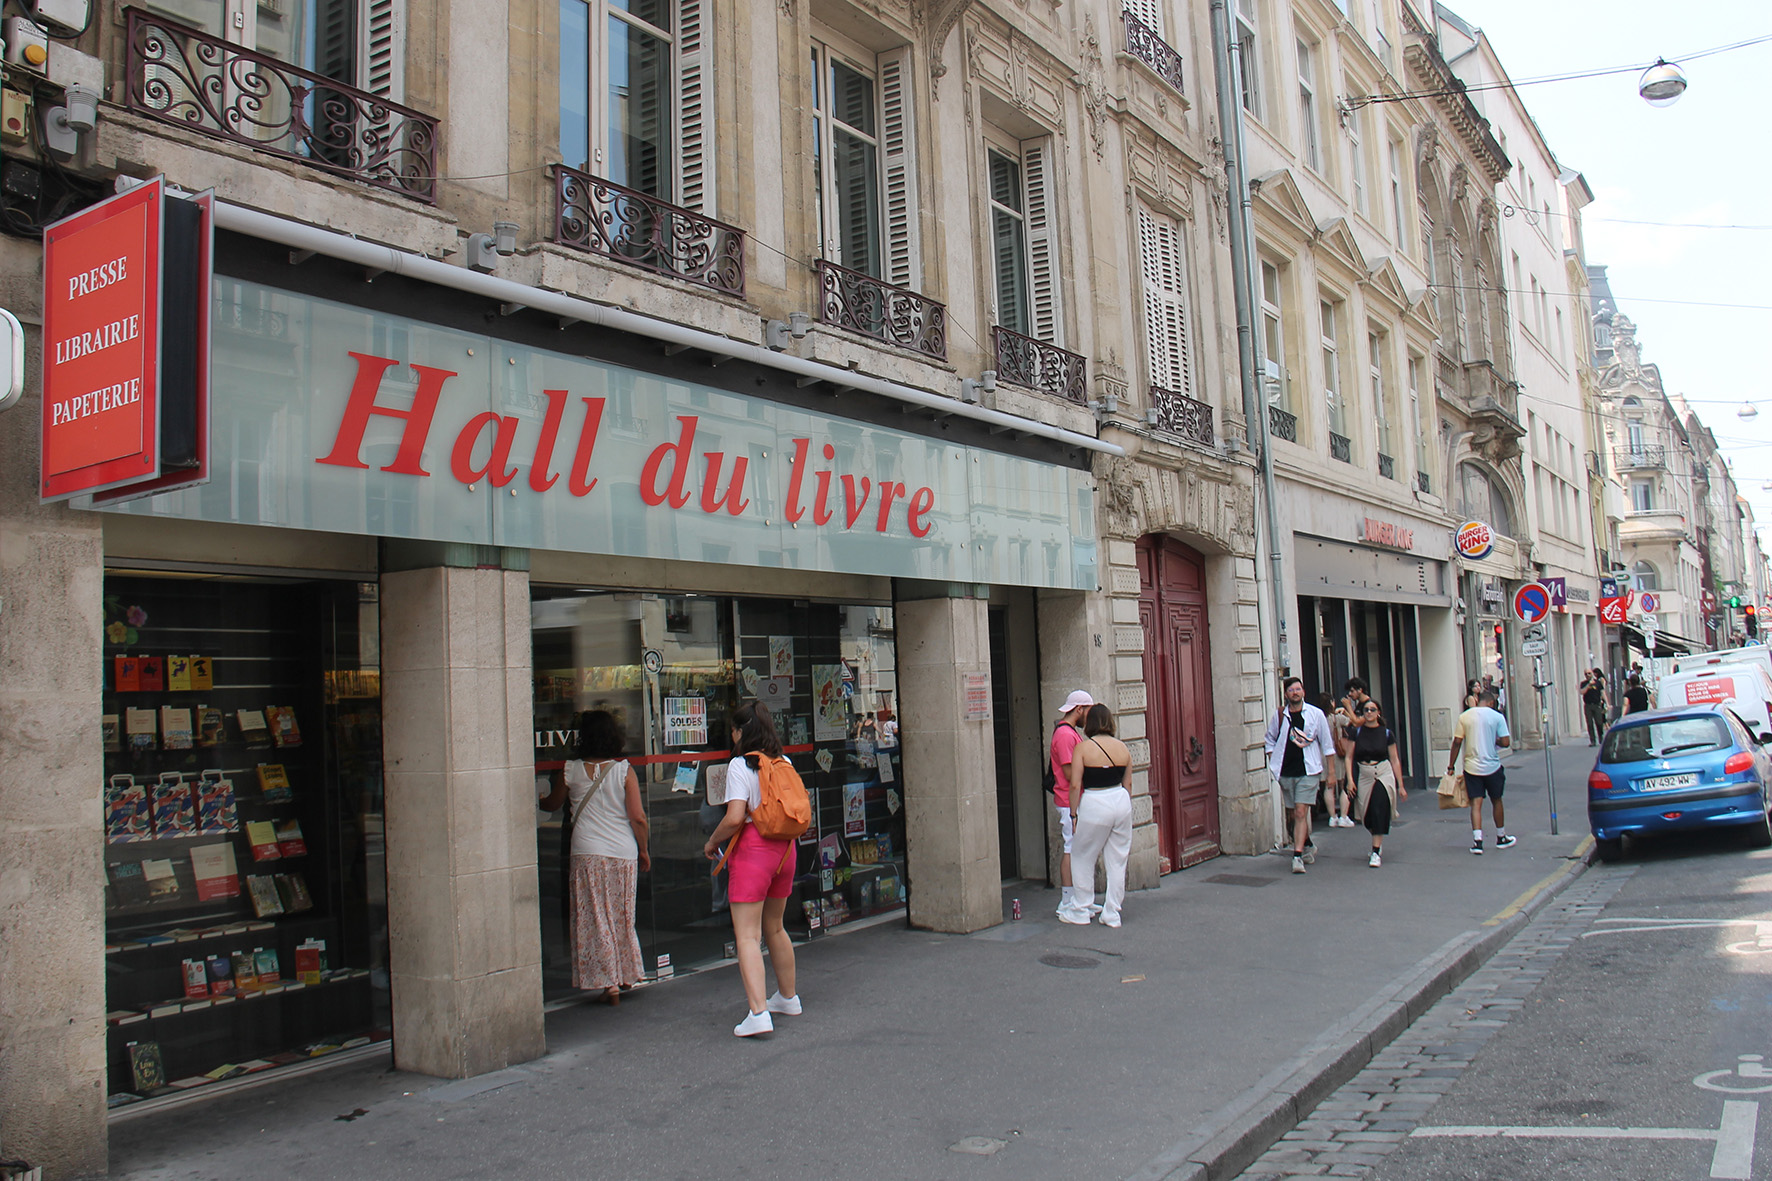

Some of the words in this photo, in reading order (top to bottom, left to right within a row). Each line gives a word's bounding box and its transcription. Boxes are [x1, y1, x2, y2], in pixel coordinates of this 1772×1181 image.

[68, 256, 127, 300] PRESSE
[55, 314, 139, 365] LIBRAIRIE
[52, 377, 140, 427] PAPETERIE
[315, 351, 606, 498] Hall
[639, 415, 750, 518] du
[783, 437, 935, 539] livre
[1365, 517, 1395, 547] BURGER
[1396, 527, 1414, 551] KING
[1458, 526, 1488, 543] BURGER
[1459, 532, 1490, 552] KING
[670, 716, 702, 727] SOLDES
[1645, 778, 1657, 789] AV
[1659, 776, 1675, 788] 492
[1678, 775, 1690, 786] WW
